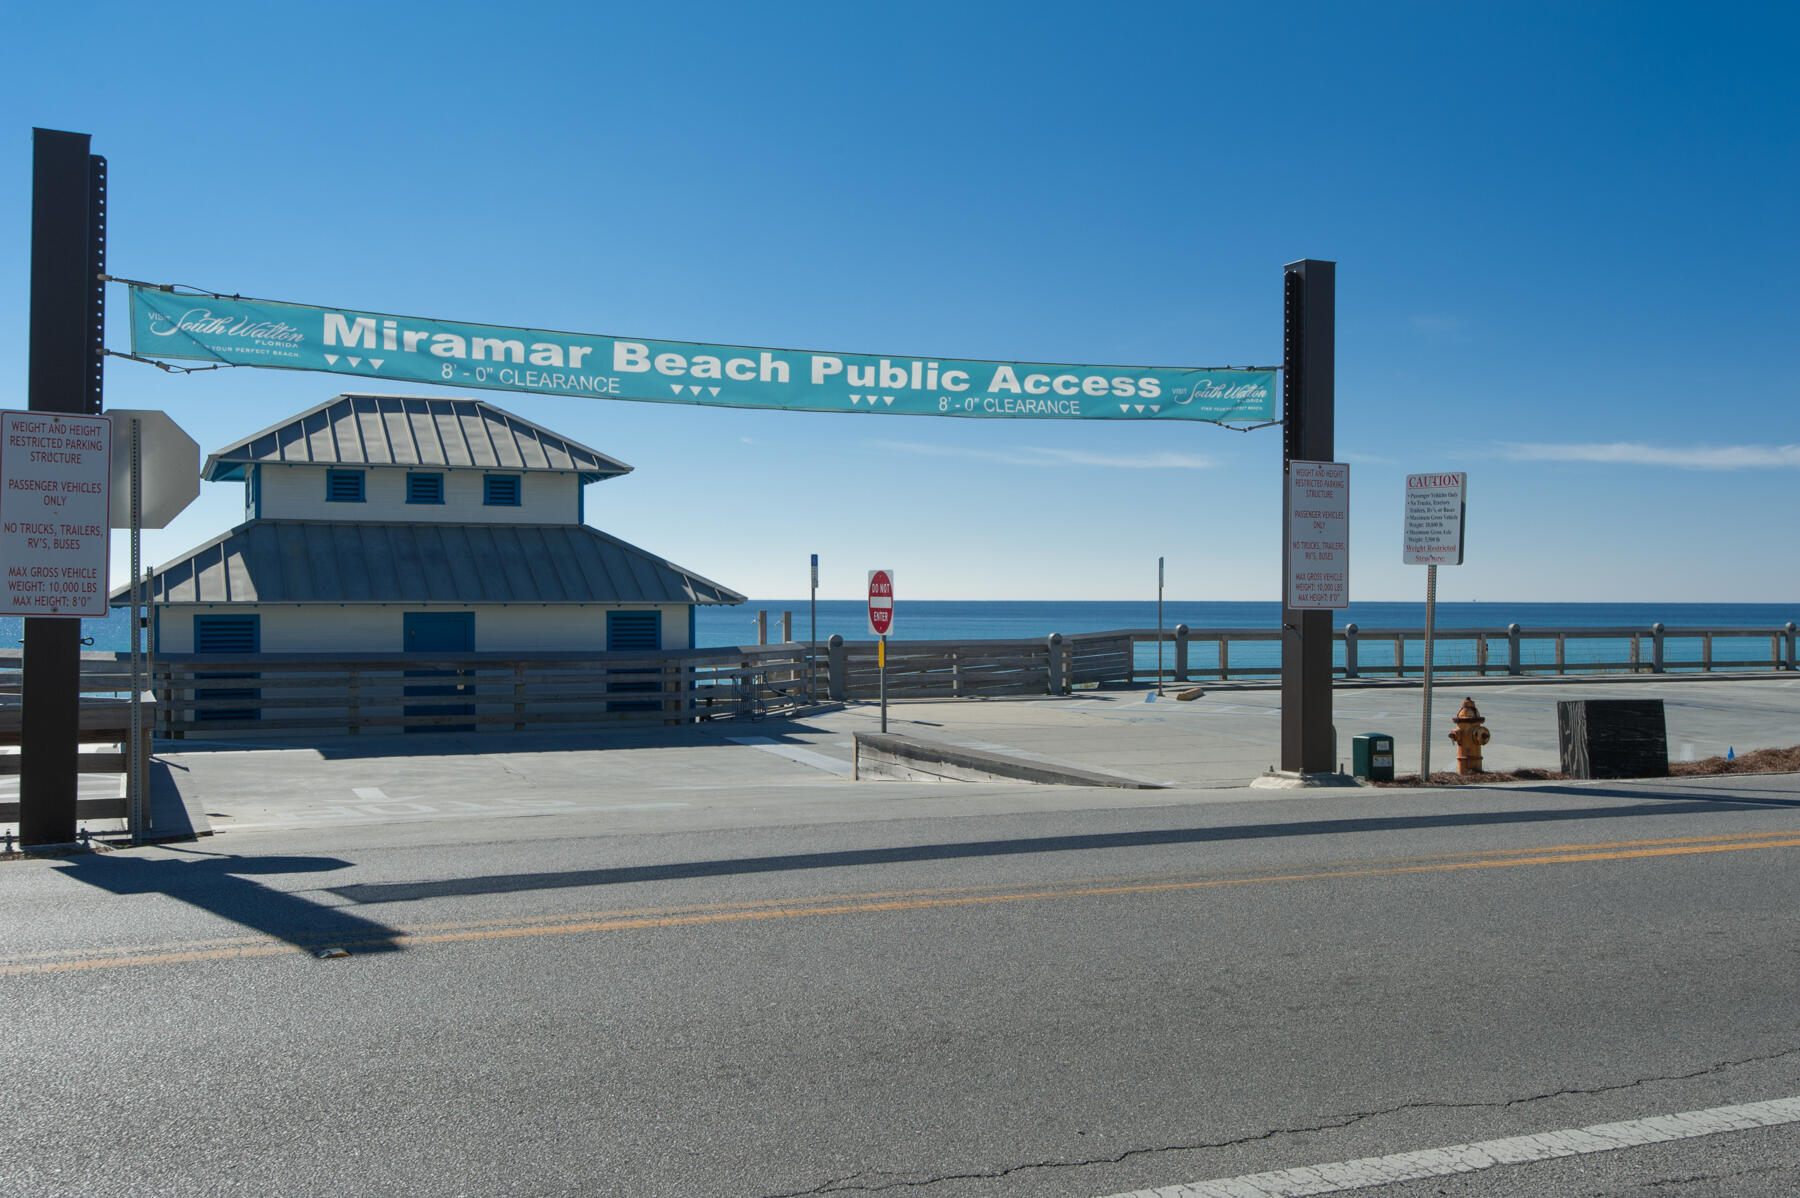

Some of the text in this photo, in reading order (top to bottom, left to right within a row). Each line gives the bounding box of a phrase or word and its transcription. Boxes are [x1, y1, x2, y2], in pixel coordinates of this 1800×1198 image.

[150, 308, 234, 337] South
[227, 316, 305, 343] Walton
[255, 340, 299, 348] FLORIDA
[235, 347, 270, 355] PERFECT
[323, 313, 1161, 398] Miramar Beach Public Access
[441, 363, 457, 380] 8'
[499, 368, 621, 394] CLEARANCE
[1174, 379, 1226, 405] South
[1224, 382, 1268, 399] Walton
[939, 396, 951, 411] 8'
[983, 398, 1081, 415] CLEARANCE
[11, 421, 103, 436] WEIGHT AND HEIGHT
[9, 435, 103, 451] RESTRICTED PARKING
[30, 451, 82, 464] STRUCTURE
[1326, 470, 1344, 478] HEIGHT
[8, 479, 102, 493] PASSENGER VEHICLES
[1295, 478, 1344, 488] RESTRICTED PARKING
[1408, 474, 1460, 488] CAUTION
[1305, 489, 1333, 498] STRUCTURE
[43, 495, 67, 506] ONLY
[1295, 510, 1344, 520] PASSENGER VEHICLES
[4, 523, 103, 537] NO TRUCKS, TRAILERS,
[1313, 520, 1326, 529] ONLY
[28, 538, 80, 550] RV'S, BUSES
[1293, 542, 1301, 550] NO
[1406, 544, 1456, 552] Weight Restricted
[1318, 552, 1333, 560] BUSES
[8, 566, 97, 579] MAX GROSS VEHICLE
[1296, 573, 1343, 581] MAX GROSS VEHICLE
[8, 581, 97, 594] WEIGHT: 10,000 LBS
[872, 584, 890, 593] DO NOT
[1317, 584, 1333, 592] 10,000
[1334, 584, 1343, 592] LBS
[13, 596, 92, 607] MAX HEIGHT: 8'0"
[1298, 593, 1309, 602] MAX
[874, 612, 888, 622] ENTER
